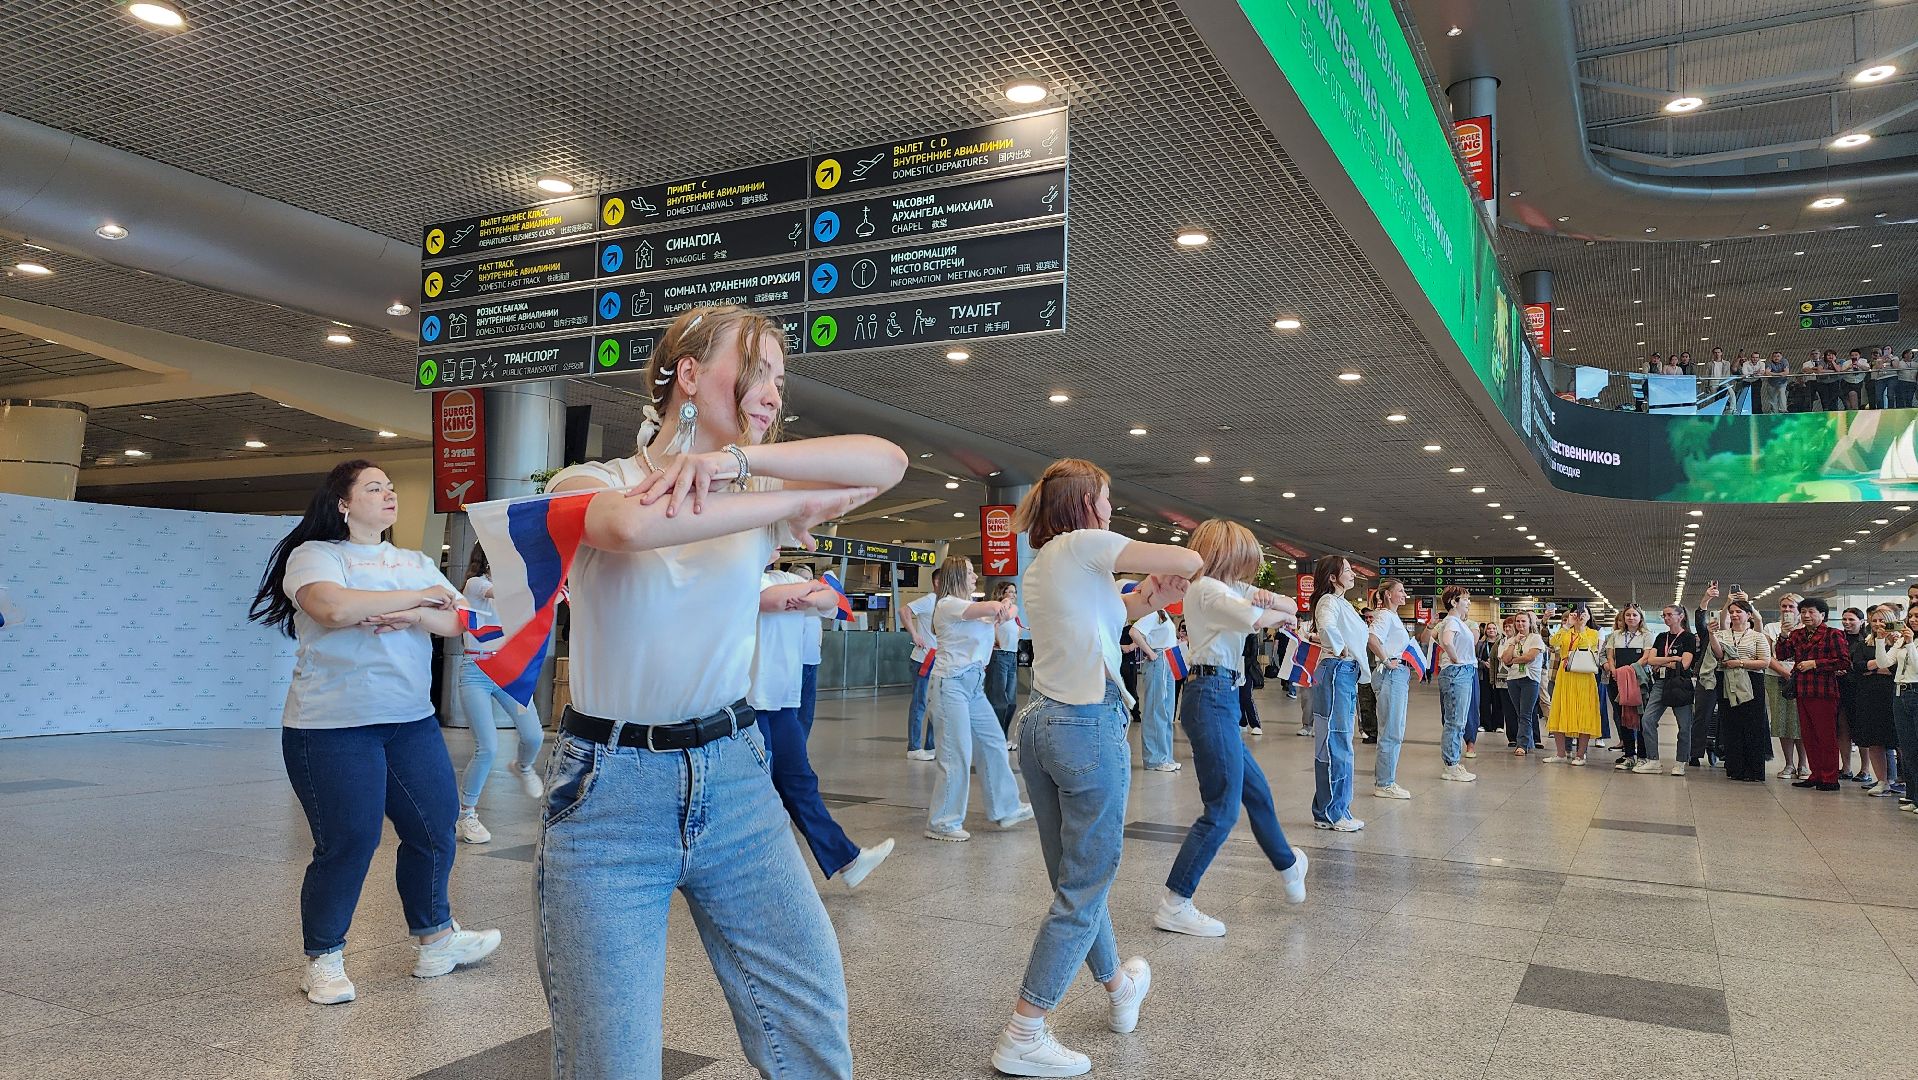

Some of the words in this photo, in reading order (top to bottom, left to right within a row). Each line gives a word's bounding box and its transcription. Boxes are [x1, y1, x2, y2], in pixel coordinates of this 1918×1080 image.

[1301, 17, 1328, 85] Ваше
[893, 142, 924, 156] ВЫЛЕТ
[941, 138, 948, 147] D
[893, 149, 951, 168] ВНУТРЕННИЕ
[954, 138, 1014, 157] АВИАЛИНИИ
[892, 164, 934, 180] DOMESTIC
[935, 155, 989, 172] DEPARTURES
[666, 191, 715, 207] ВНУТРЕННИЕ
[716, 181, 765, 197] АВИАЛИНИИ
[667, 182, 696, 195] ПРИЛЕТ
[666, 205, 700, 217] DOMESTIC
[700, 199, 734, 212] ARRIVALS
[892, 194, 935, 210] ЧАСОВНЯ
[892, 206, 944, 222] АРХАНГЕЛА
[946, 198, 994, 213] МИХАИЛА
[480, 216, 501, 228] ВЫЛЕТ
[502, 211, 526, 224] БИЗНЕС
[527, 208, 550, 220] КЛАСС
[480, 224, 520, 237] ВНУТРЕННИЕ
[521, 216, 562, 230] АВИАЛИНИИ
[892, 221, 923, 234] CHAPEL
[479, 236, 512, 247] DEPARTURES
[513, 231, 538, 242] BUSINESS
[539, 228, 556, 238] CLASS
[666, 231, 722, 251] СИНАГОГА
[665, 252, 706, 266] SYNAGOGUE
[890, 245, 957, 263] ИНФОРМАЦИЯ
[478, 263, 494, 272] FAST
[495, 259, 515, 268] TRACK
[479, 268, 519, 282] ВНУТРЕННИЕ
[520, 262, 561, 275] АВИАЛИНИИ
[890, 262, 921, 275] МЕСТО
[923, 257, 965, 271] ВСТРЕЧИ
[478, 281, 507, 292] DOMESTIC
[507, 279, 520, 288] FAST
[522, 276, 540, 286] TRACK
[664, 283, 708, 298] КОМНАТА
[709, 277, 758, 293] ХРАНЕНИЯ
[760, 271, 801, 286] ОРУЖИЯ
[890, 274, 941, 287] INFORMATION
[947, 270, 981, 281] MEETING
[983, 266, 1008, 276] POINT
[477, 305, 502, 317] РОЗЫСК
[503, 302, 528, 313] БАГАЖА
[664, 303, 692, 313] WEAPON
[726, 296, 747, 306] ROOM
[949, 302, 1001, 319] ТУАЛЕТ
[476, 314, 516, 326] ВНУТРЕННИЕ
[518, 308, 559, 321] АВИАЛИНИИ
[476, 325, 504, 337] DOMESTIC
[949, 323, 979, 335] TOILET
[984, 321, 1010, 332] 洗手间
[504, 349, 560, 364] ТРАНСПОРТ
[632, 344, 650, 354] EXIT
[502, 367, 523, 377] PUBLIC
[523, 364, 558, 375] TRANSPORT
[443, 406, 474, 417] BURGER
[443, 416, 474, 431] KING
[444, 448, 450, 458] 2
[847, 542, 852, 553] 3
